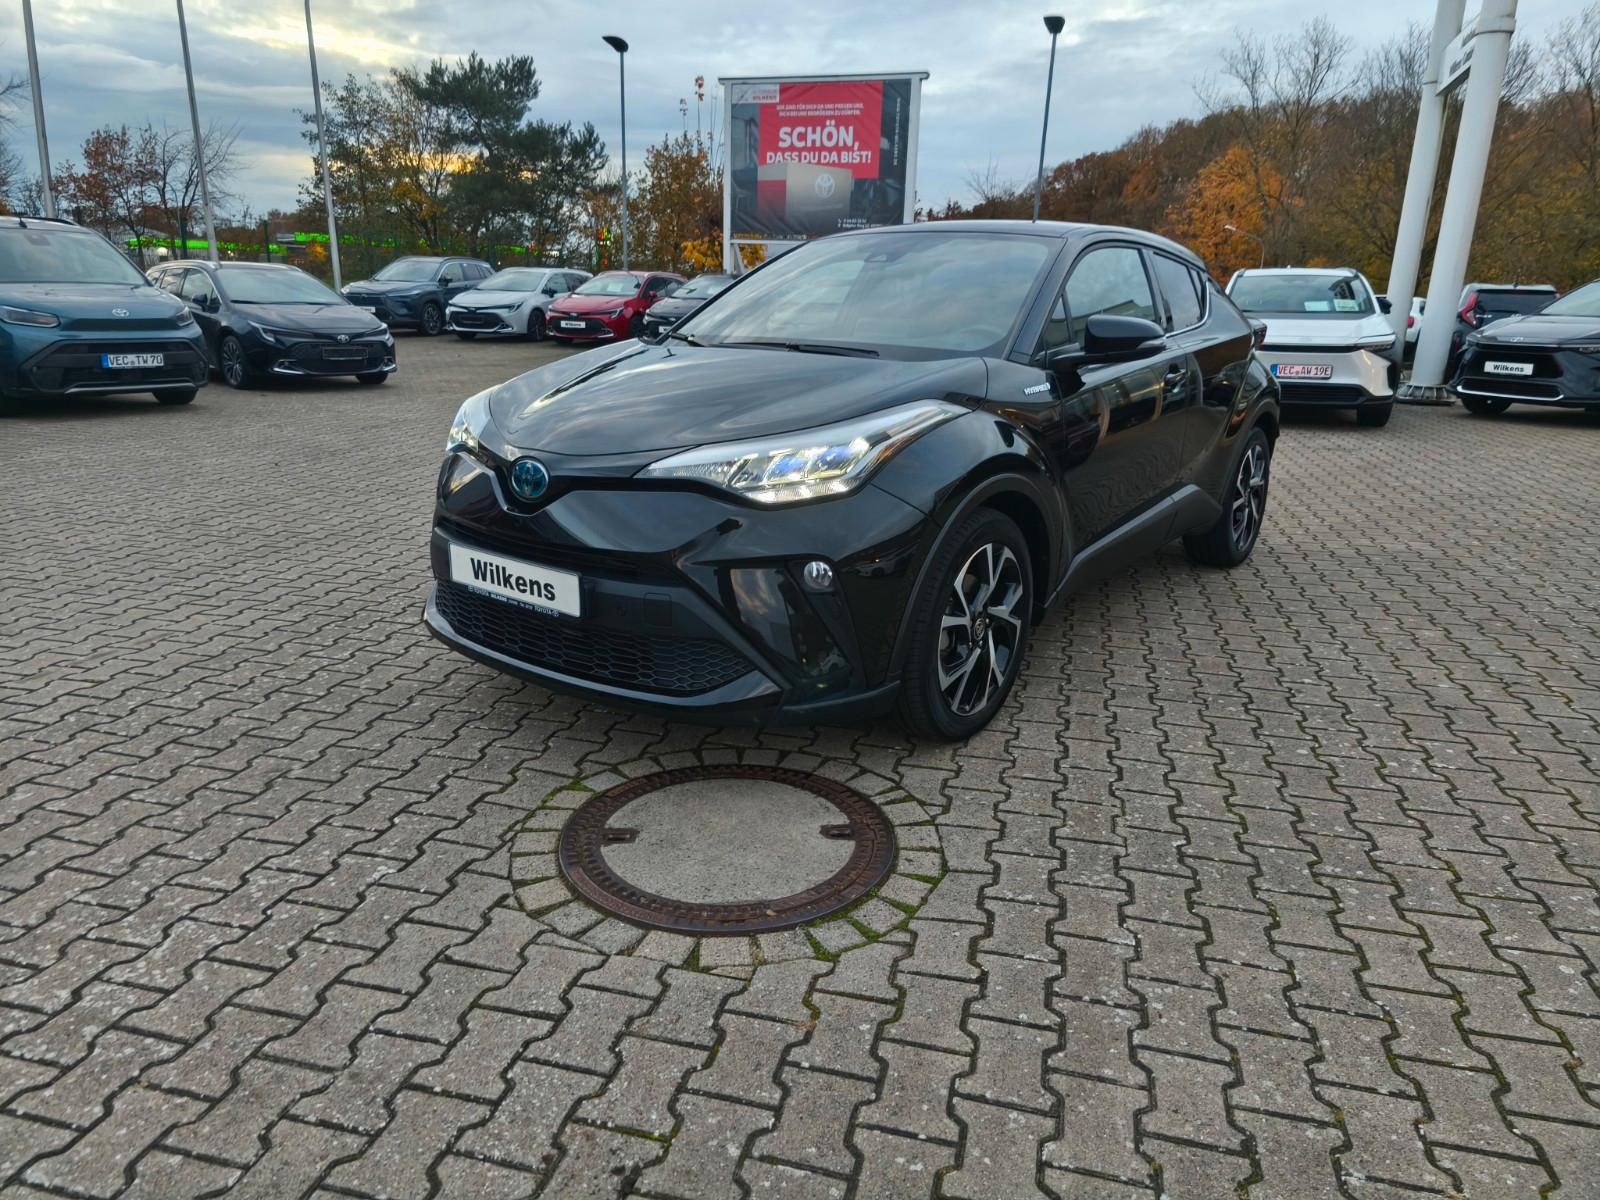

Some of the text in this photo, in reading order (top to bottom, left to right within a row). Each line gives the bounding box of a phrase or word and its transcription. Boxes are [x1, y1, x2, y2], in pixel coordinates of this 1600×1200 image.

[778, 120, 859, 150] SCHÖN,
[766, 151, 872, 163] DASS DU DA BIST!
[109, 355, 129, 366] VEC
[150, 354, 163, 365] 70
[1278, 365, 1295, 375] VEC
[1493, 364, 1524, 373] Wilkens
[470, 557, 556, 602] Wilkens
